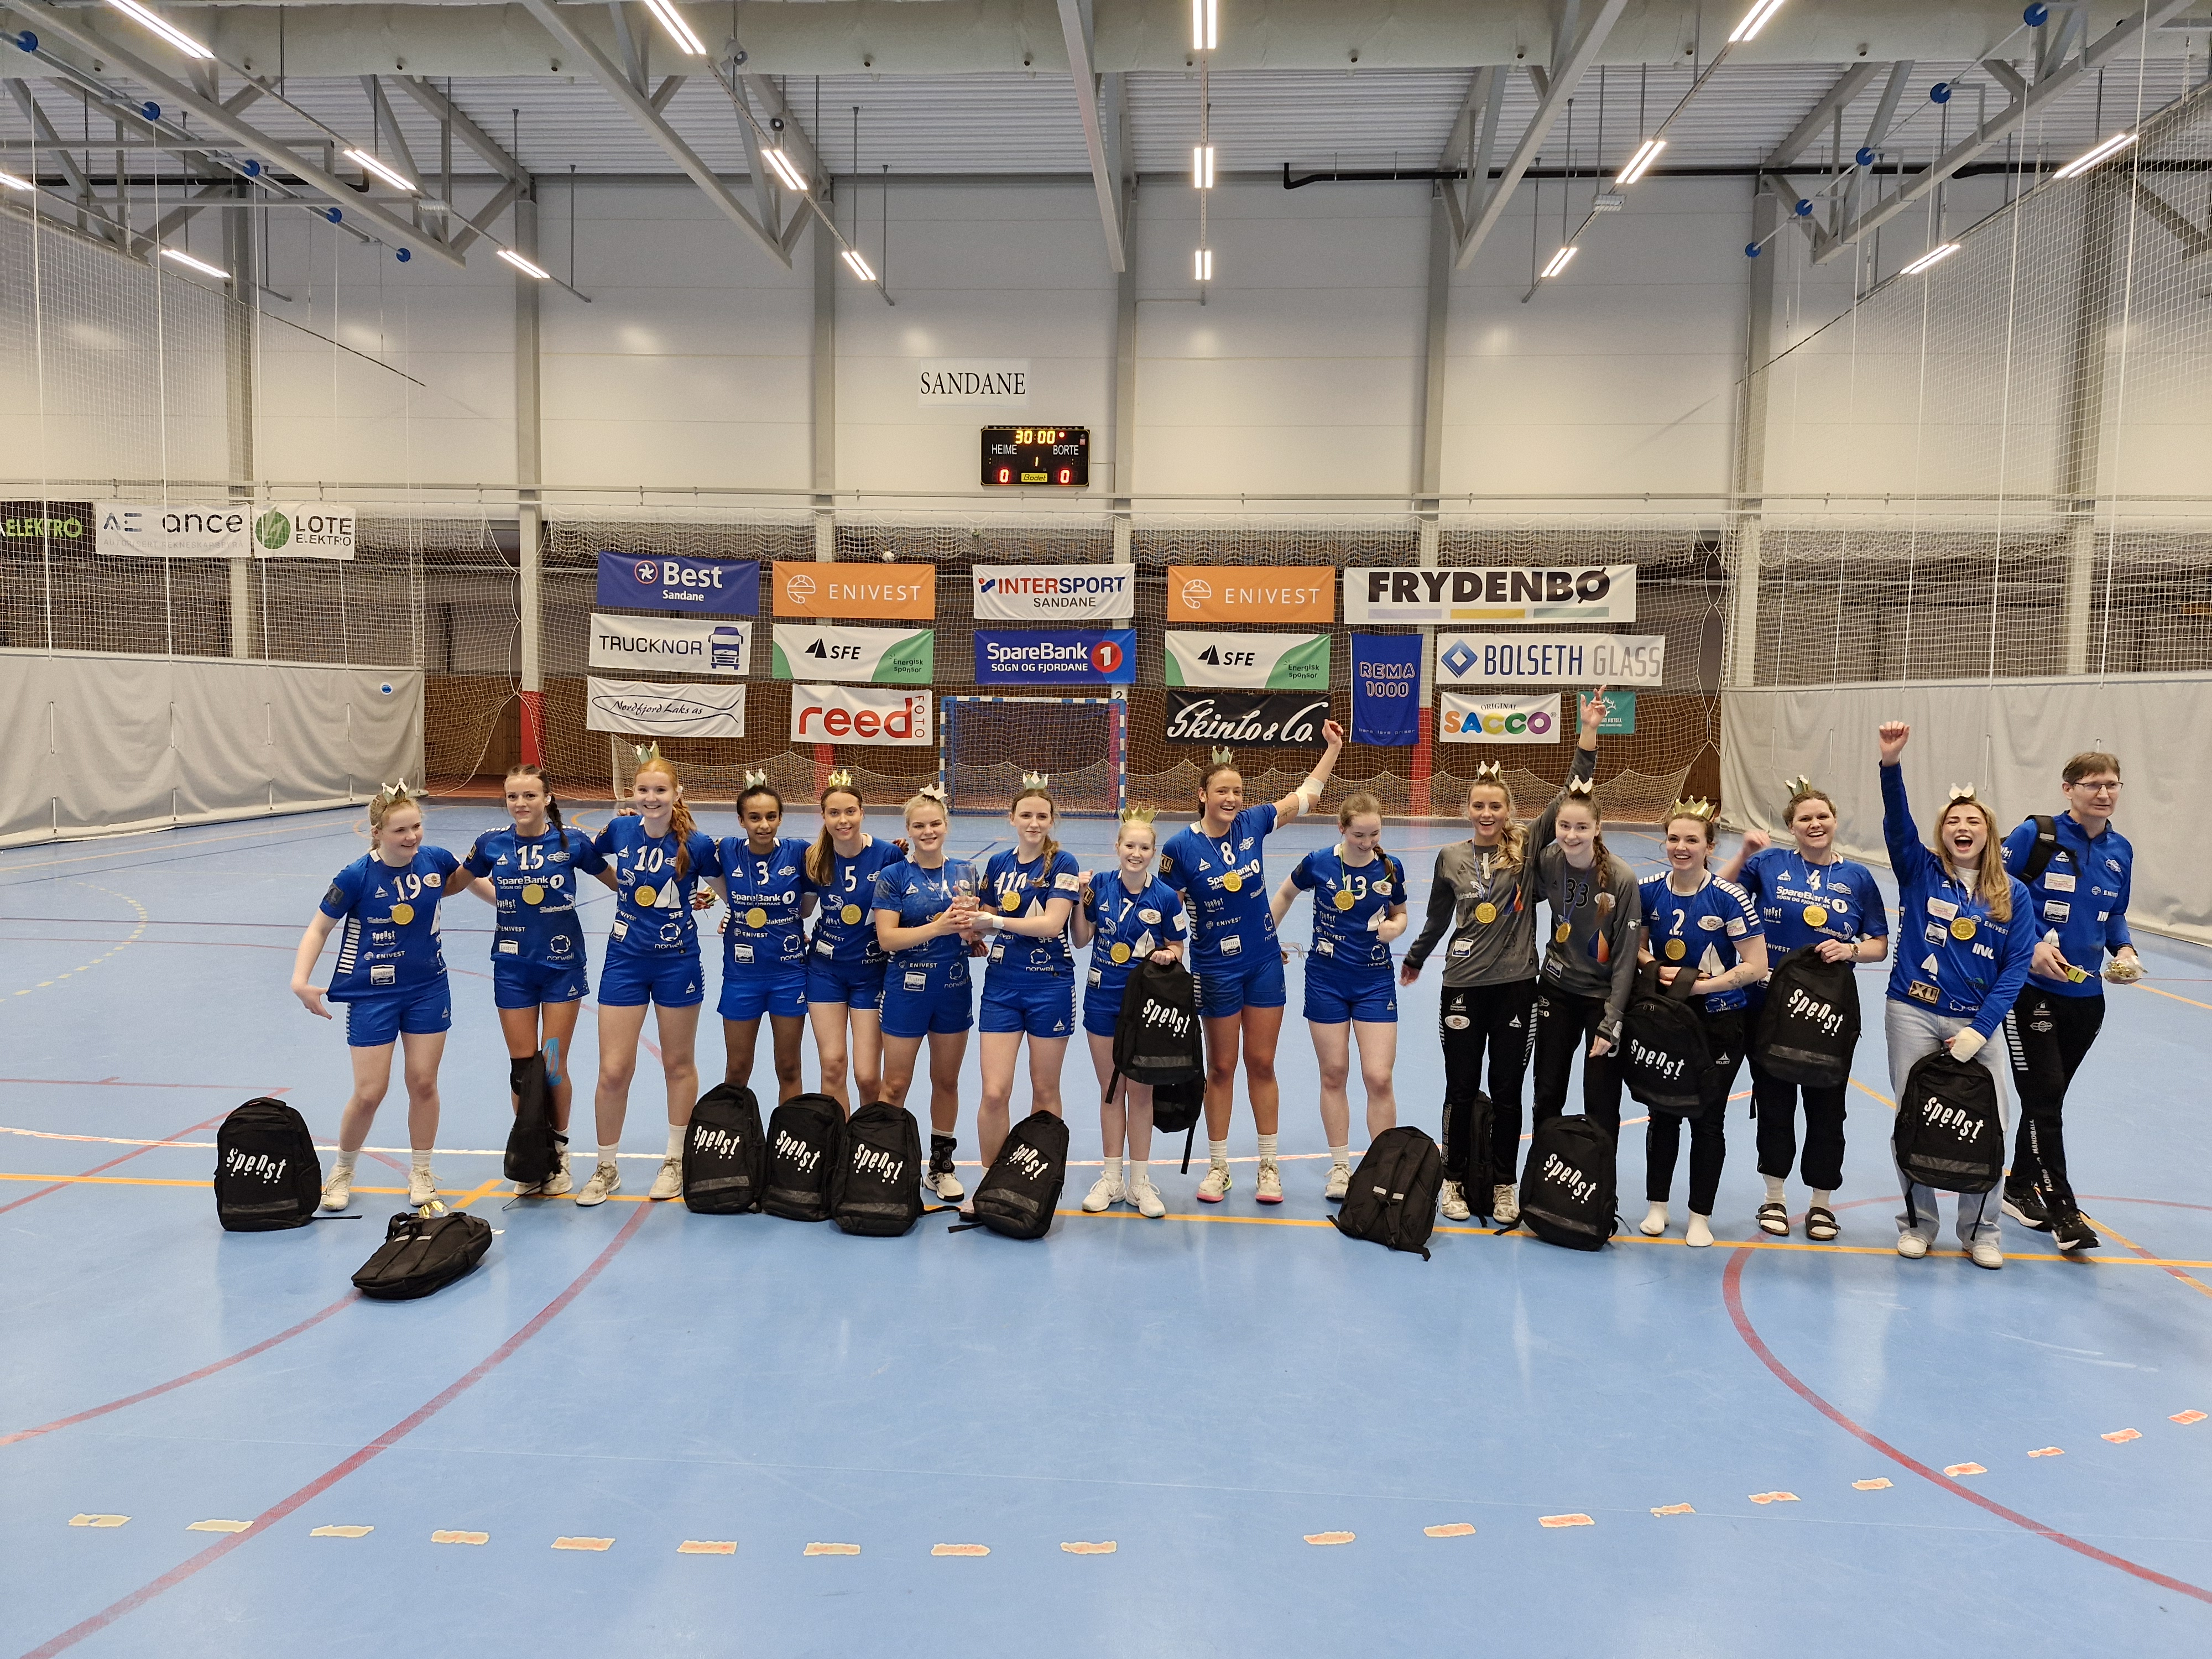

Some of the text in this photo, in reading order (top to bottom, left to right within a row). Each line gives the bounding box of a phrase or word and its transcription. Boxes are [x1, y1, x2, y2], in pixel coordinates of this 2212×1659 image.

[921, 372, 1026, 394] SANDANE
[992, 444, 1018, 455] HEIME
[1053, 445, 1079, 455] BORTE
[1000, 469, 1009, 483] 0
[1061, 469, 1070, 483] 0
[6, 517, 82, 538] ELEKTRO
[296, 515, 352, 535] LOTE
[296, 534, 352, 546] ELEKTRO
[663, 561, 723, 588] Best
[999, 576, 1126, 594] INTERSPORT
[662, 589, 705, 602] Sandane
[829, 584, 921, 601] ENIVEST
[1225, 588, 1320, 604] ENIVEST
[1368, 567, 1610, 604] FRYDENBØ
[1034, 597, 1096, 607] SANDANE
[599, 635, 702, 655] TRUCKNOR
[830, 645, 861, 660] SFE
[987, 642, 1112, 666] SpareBank 1
[893, 658, 924, 666] Energisk
[1038, 663, 1088, 673] FJORDANE
[1223, 652, 1255, 666] SFE
[1484, 645, 1660, 677] BOLSETH GLASS
[1359, 661, 1415, 679] REMA
[1115, 691, 1123, 699] 2
[1366, 681, 1409, 698] 1000
[610, 700, 662, 716] Nordfjord
[663, 703, 690, 714] Laks
[799, 697, 912, 738] reed
[914, 695, 925, 738] FOTO
[1262, 722, 1279, 741] &
[1280, 702, 1329, 742] Co.
[1443, 711, 1551, 734] SACCO
[517, 845, 544, 870] 15
[634, 846, 664, 873] 10
[1220, 842, 1236, 865] 8
[497, 875, 549, 885] SpareBank
[755, 861, 769, 885] 3
[844, 865, 857, 893] 5
[1806, 869, 1822, 890] 4
[392, 873, 421, 902] 19
[1345, 874, 1367, 900] 13
[1564, 877, 1589, 908] 33
[1776, 886, 1831, 904] SpareBank
[669, 910, 684, 920] SFE
[1119, 898, 1134, 922] 7
[2048, 905, 2067, 913] Bistro
[1217, 916, 1242, 926] ENIVEST
[1669, 909, 1685, 936] 2
[823, 931, 845, 942] ENIVEST
[1323, 931, 1346, 941] ENIVEST
[376, 951, 405, 959] ENIVEST
[547, 952, 574, 961] norwell
[1765, 943, 1791, 953] NIVEST
[1141, 998, 1190, 1038] spenst
[1787, 988, 1844, 1036] spenst
[1630, 1039, 1685, 1080] spenst
[1922, 1097, 1984, 1144] spenst
[693, 1125, 740, 1159] spenst
[2030, 1119, 2039, 1155] HANDBALL
[775, 1130, 821, 1173] spenst
[1005, 1143, 1048, 1181] spenst
[227, 1147, 286, 1183] spenst
[853, 1143, 904, 1185] spenst
[1543, 1153, 1597, 1204] spenst
